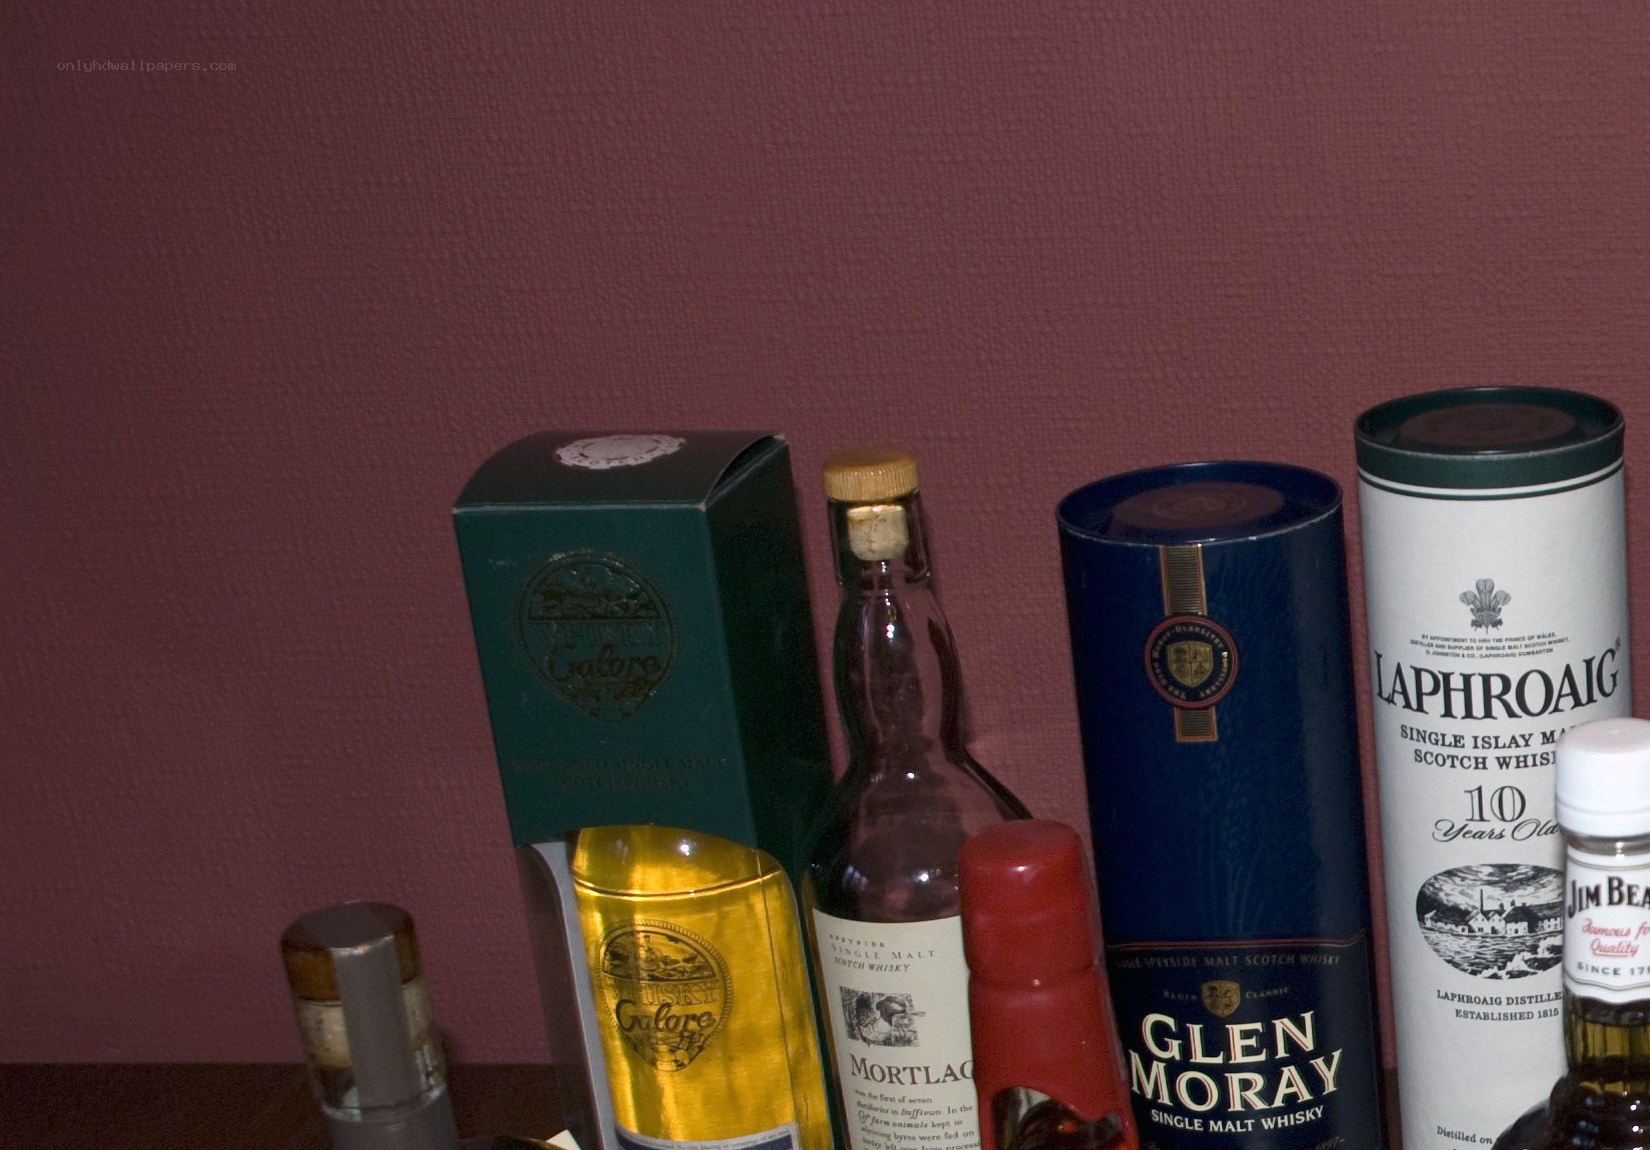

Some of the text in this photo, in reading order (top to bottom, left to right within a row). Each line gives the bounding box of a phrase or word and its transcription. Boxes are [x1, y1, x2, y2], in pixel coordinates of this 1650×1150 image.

[1374, 644, 1619, 720] LAPHROAIG
[1400, 724, 1534, 751] SINGLE ISLAY
[1413, 748, 1489, 771] SCOTCH
[1463, 785, 1527, 824] 10
[1431, 818, 1507, 843] Years
[1566, 879, 1603, 920] JIM
[1582, 917, 1632, 938] Famous
[1590, 937, 1641, 958] Quality
[867, 960, 912, 973] WHISKY
[1203, 955, 1239, 967] MALT
[1244, 954, 1295, 967] SCOTCH
[1300, 953, 1343, 966] WHISKY
[1576, 961, 1622, 977] SINCE
[1435, 989, 1503, 1006] LAPHROAIG
[615, 999, 718, 1034] Galore
[1455, 1006, 1560, 1022] ESTABLISHED 1815
[1140, 1010, 1316, 1066] GLEN
[1128, 1047, 1344, 1113] MORAY
[1151, 1105, 1325, 1133] SINGLE MALT WHISKY
[1436, 1125, 1493, 1146] Distilled on
